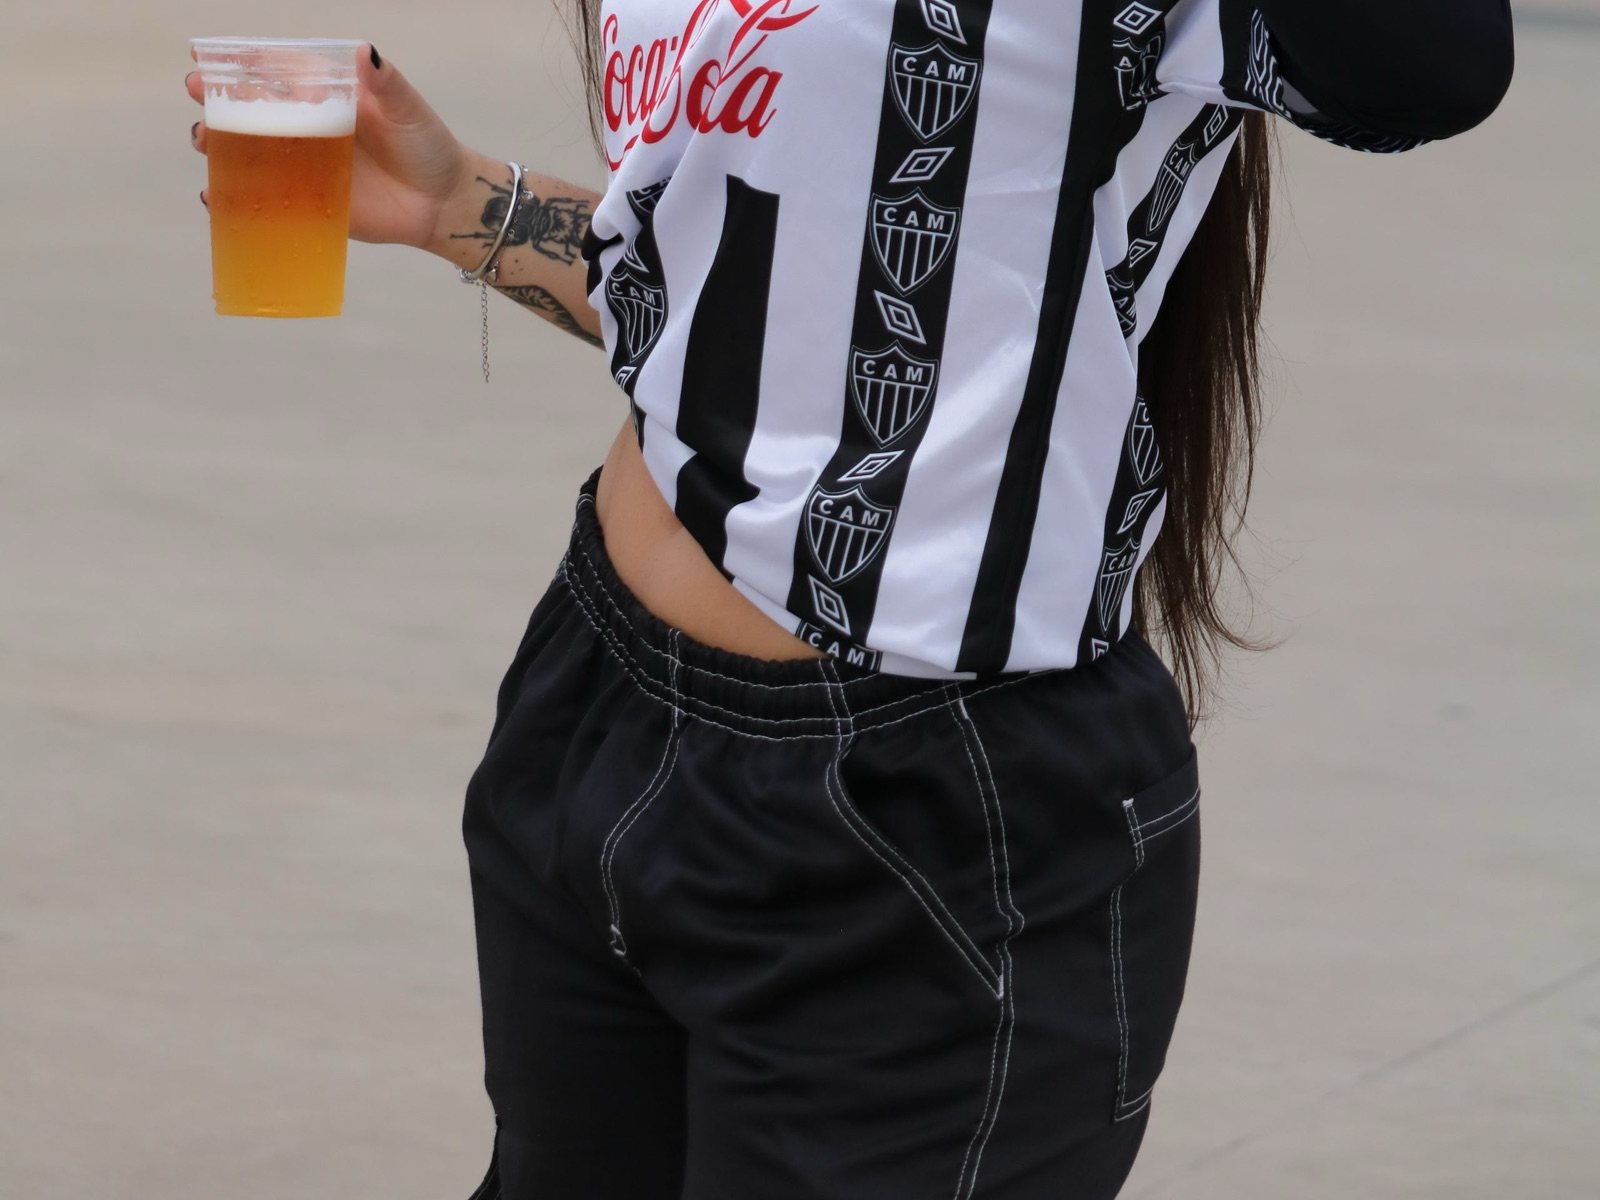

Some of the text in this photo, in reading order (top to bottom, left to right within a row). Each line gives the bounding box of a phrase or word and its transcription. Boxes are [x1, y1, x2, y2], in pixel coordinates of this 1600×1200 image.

[903, 56, 966, 81] CAM
[1169, 151, 1190, 178] CAM
[883, 207, 945, 230] CAM
[612, 282, 656, 306] CAM
[863, 360, 923, 382] CAM
[819, 499, 880, 527] CAM
[1108, 551, 1136, 571] CAM
[808, 632, 865, 667] CAM
